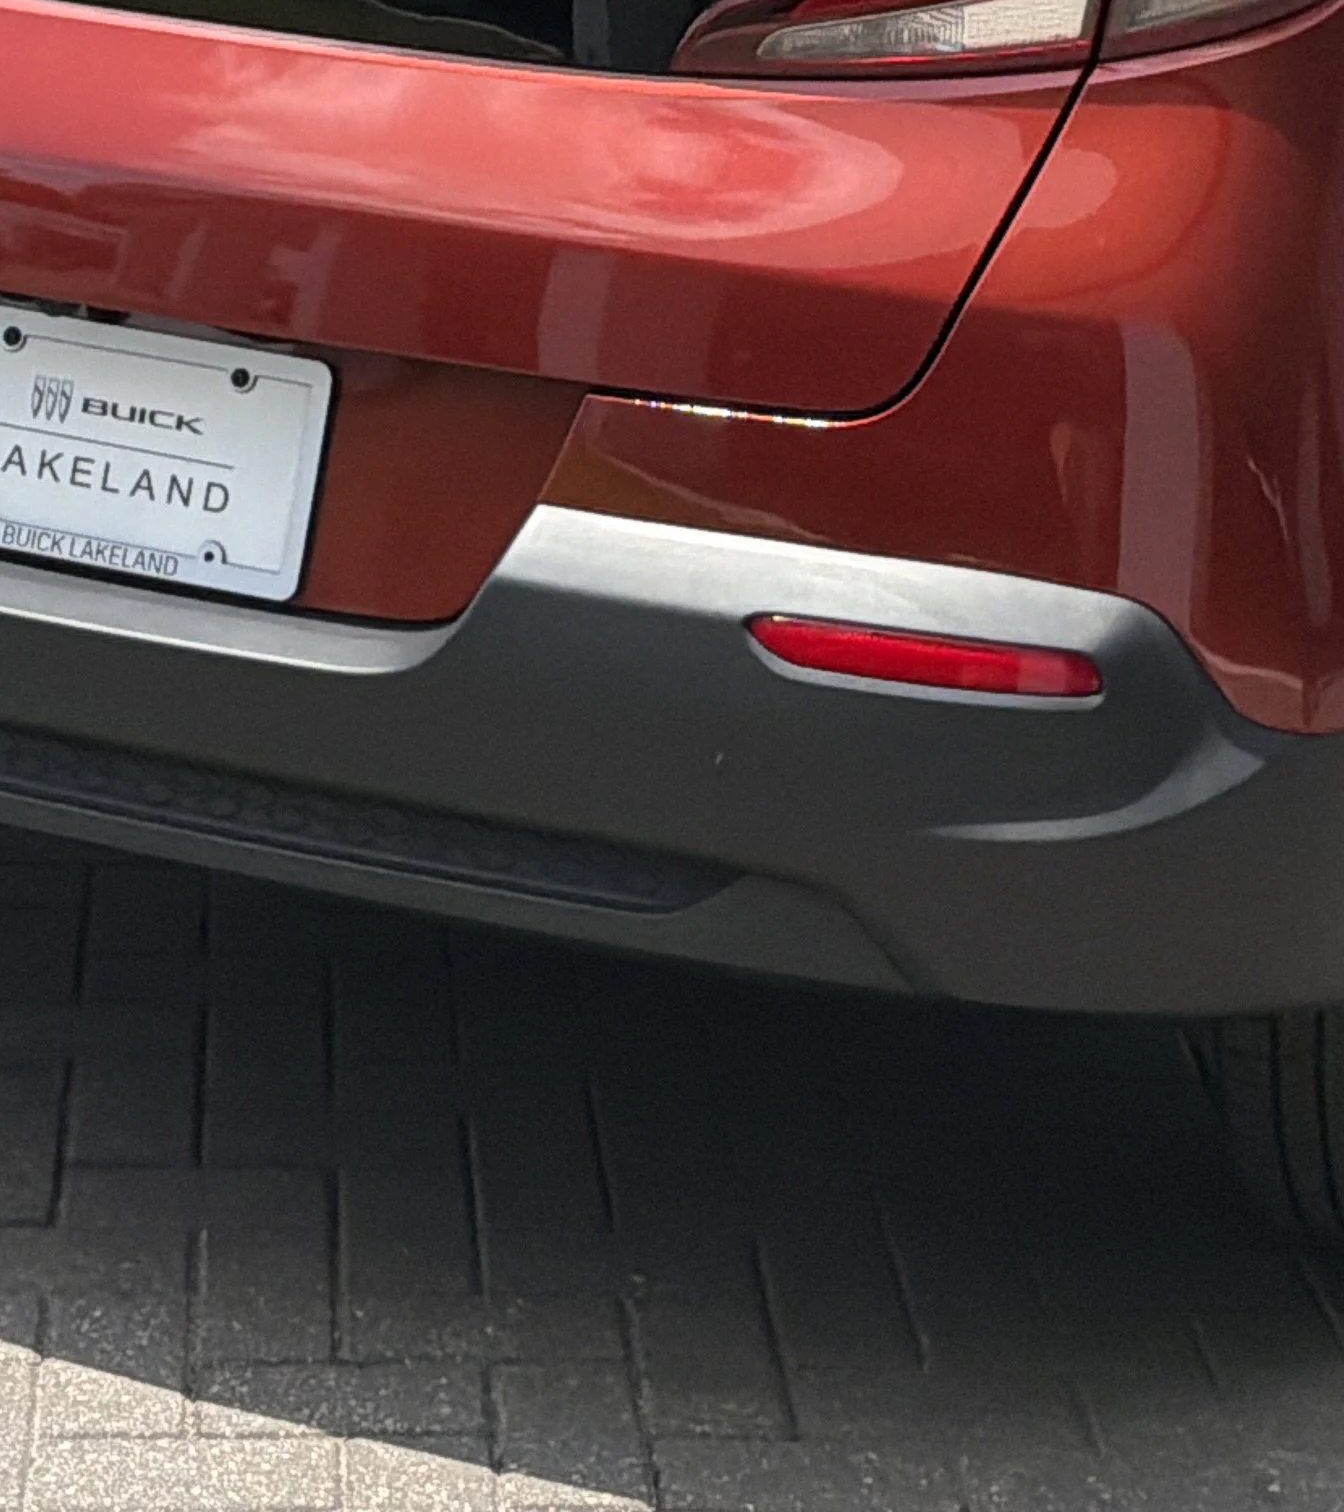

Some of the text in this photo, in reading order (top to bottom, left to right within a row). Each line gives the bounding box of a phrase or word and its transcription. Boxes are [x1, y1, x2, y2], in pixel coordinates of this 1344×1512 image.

[81, 397, 205, 435] BUICK
[1, 523, 179, 577] BUICK LAKELAND
